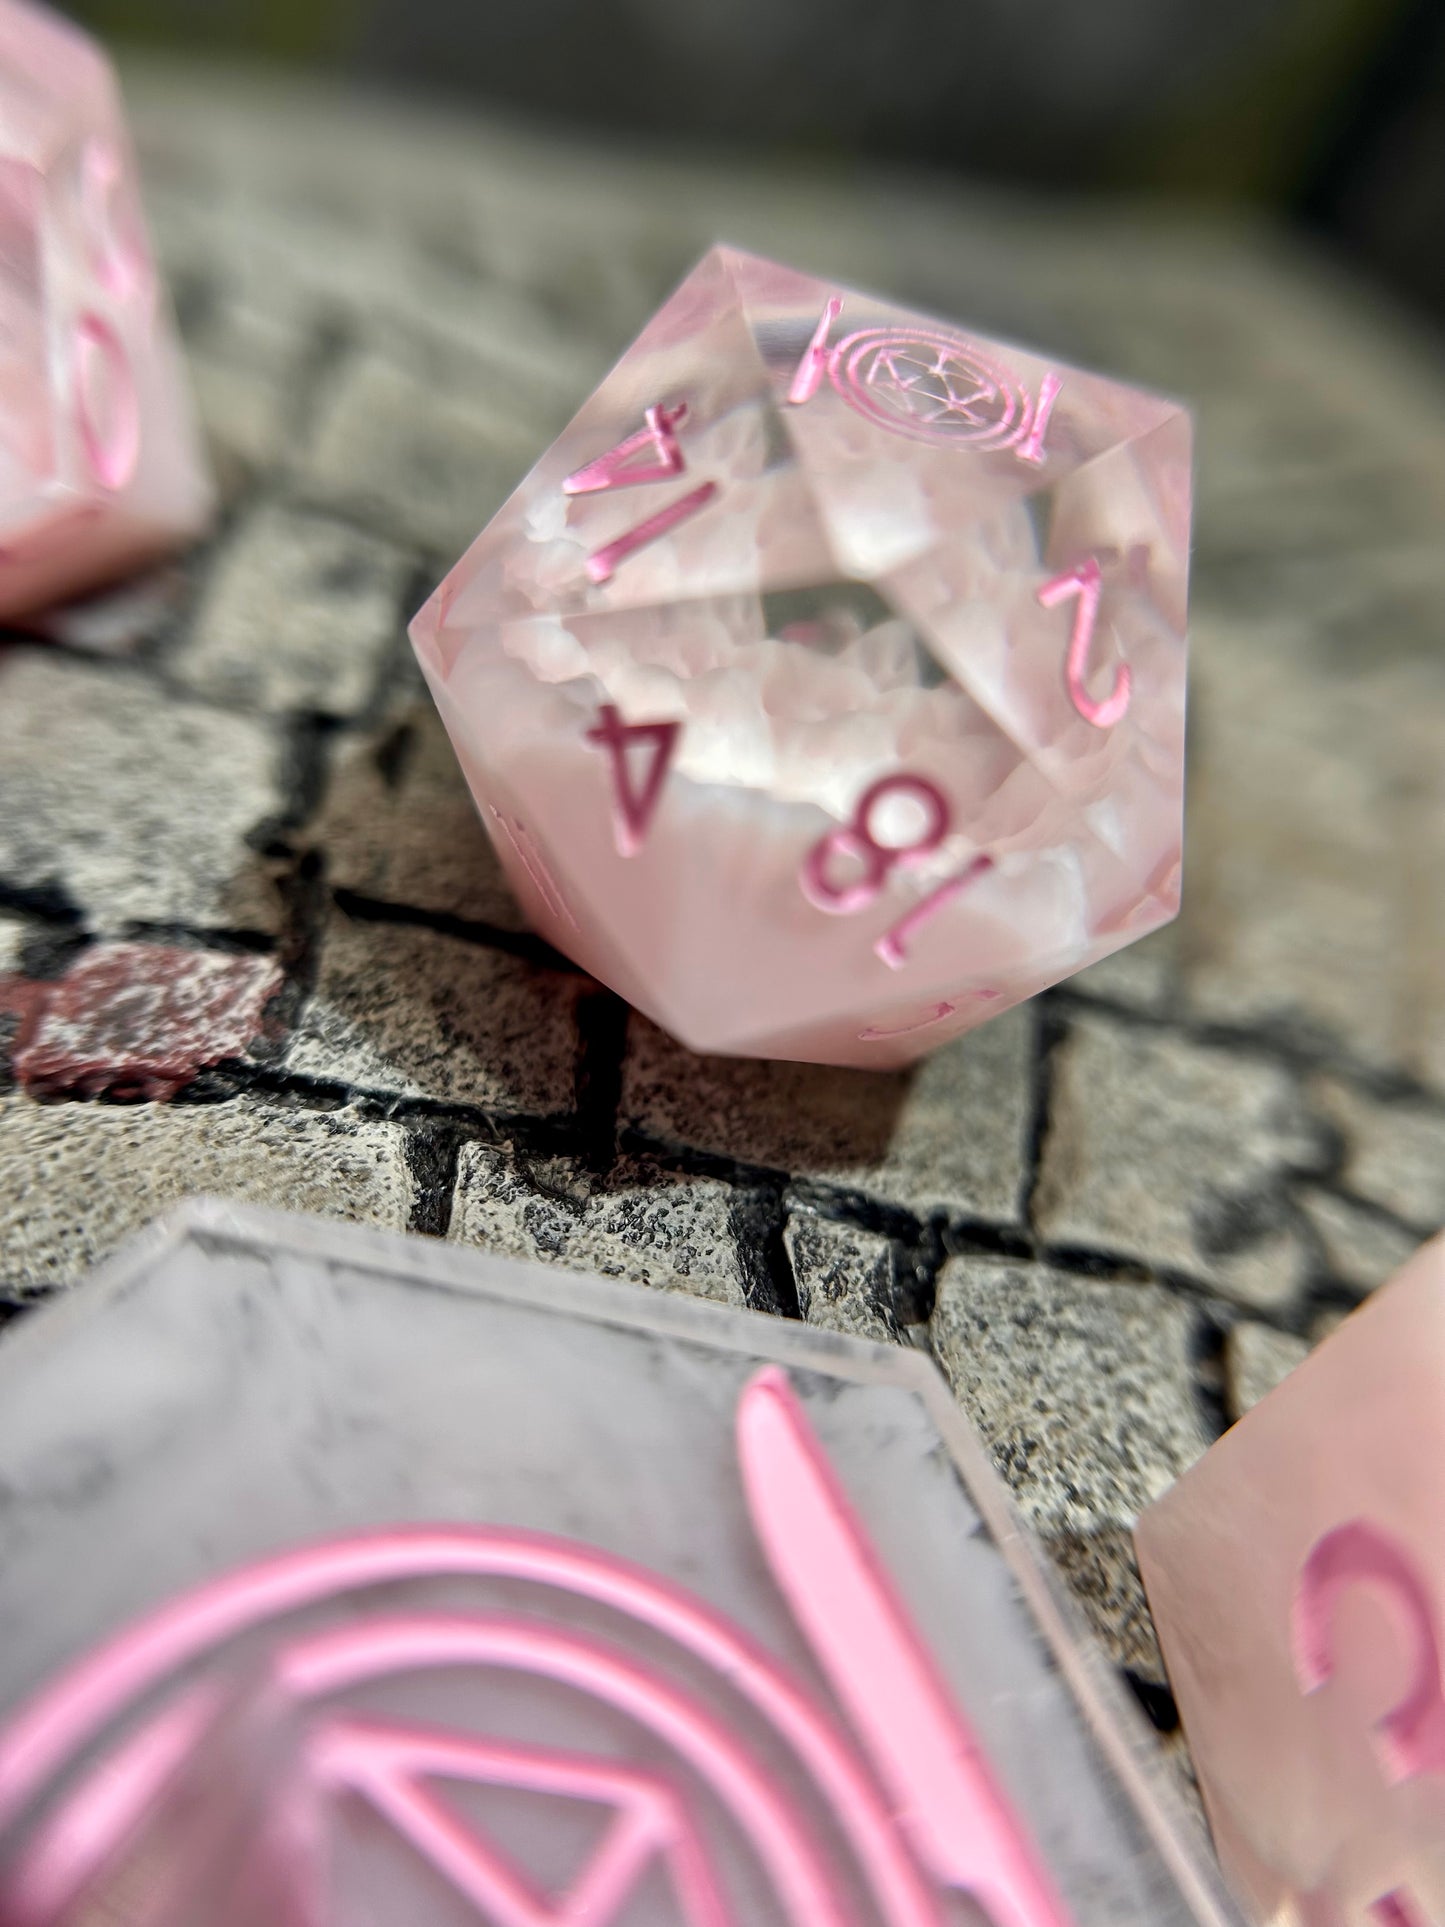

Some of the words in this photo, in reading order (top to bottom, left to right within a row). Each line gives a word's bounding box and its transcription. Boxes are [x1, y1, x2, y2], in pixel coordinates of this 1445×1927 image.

[562, 402, 718, 583] 14
[586, 702, 682, 860] 4
[802, 772, 994, 970] 18
